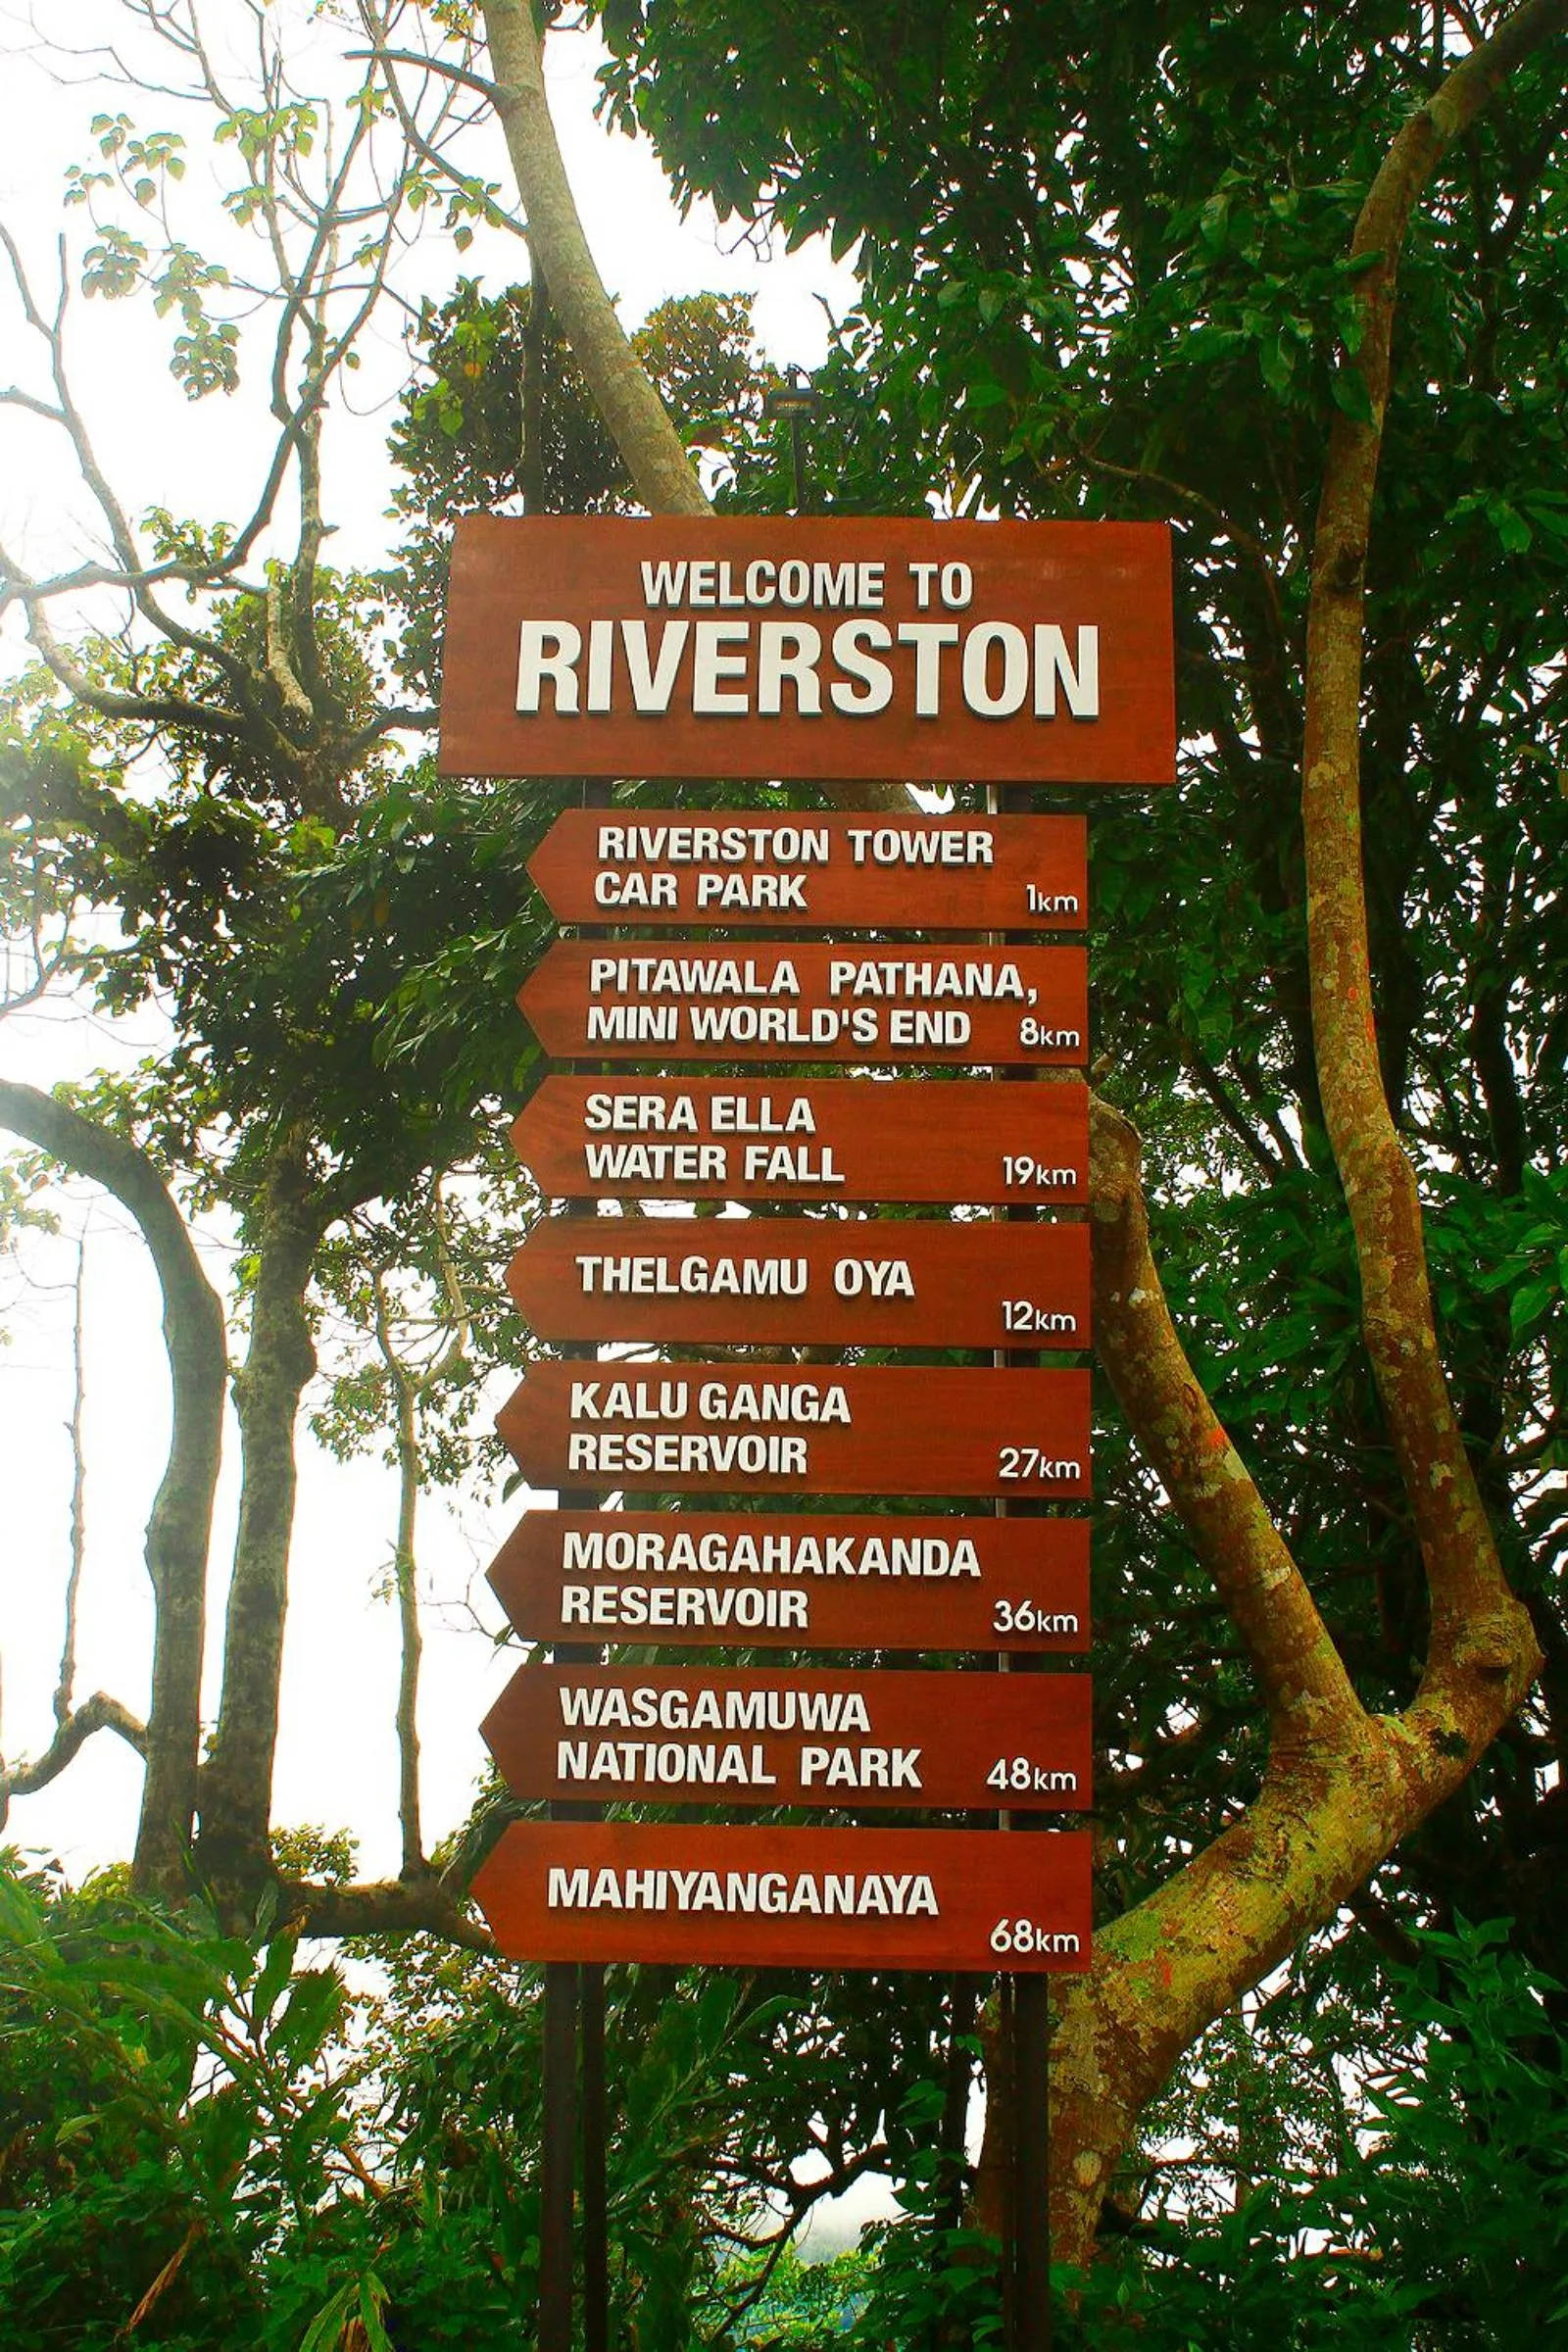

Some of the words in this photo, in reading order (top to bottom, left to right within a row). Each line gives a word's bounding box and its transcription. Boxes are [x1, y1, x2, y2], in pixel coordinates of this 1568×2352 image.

[641, 560, 885, 607] WELCOME
[908, 562, 974, 608] TO
[515, 618, 1100, 717] RIVERSTON
[598, 826, 830, 862] RIVERSTON
[848, 829, 995, 864] TOWER
[594, 871, 679, 906] CAR
[697, 873, 808, 909] PARK
[1025, 884, 1079, 912] 1km
[590, 957, 802, 996] PITAWALA
[830, 960, 1039, 1004] PATHANA,
[587, 1005, 678, 1042] MINI
[689, 1005, 879, 1045] WORLD'S
[890, 1009, 971, 1046] END
[1019, 1017, 1081, 1047] 8km
[584, 1094, 699, 1133] SERA
[710, 1096, 816, 1133] ELLA
[584, 1144, 727, 1181] WATER
[744, 1145, 846, 1183] FALL
[1002, 1155, 1078, 1186] 19km
[575, 1255, 808, 1296] THELGAMU
[833, 1258, 916, 1298] OYA
[1002, 1300, 1077, 1332] 12km
[570, 1381, 688, 1420] KALU
[699, 1382, 852, 1424] GANGA
[568, 1433, 808, 1474] RESERVOIR
[998, 1447, 1081, 1480] 27km
[562, 1531, 983, 1579] MORAGAHAKANDA
[561, 1585, 809, 1629] RESERVOIR
[992, 1599, 1079, 1634] 36km
[559, 1687, 872, 1733] WASGAMUWA
[557, 1740, 777, 1785] NATIONAL
[800, 1746, 923, 1788] PARK
[986, 1757, 1078, 1791] 48km
[547, 1867, 940, 1916] MAHIYANGANAYA
[989, 1919, 1081, 1953] 68km
